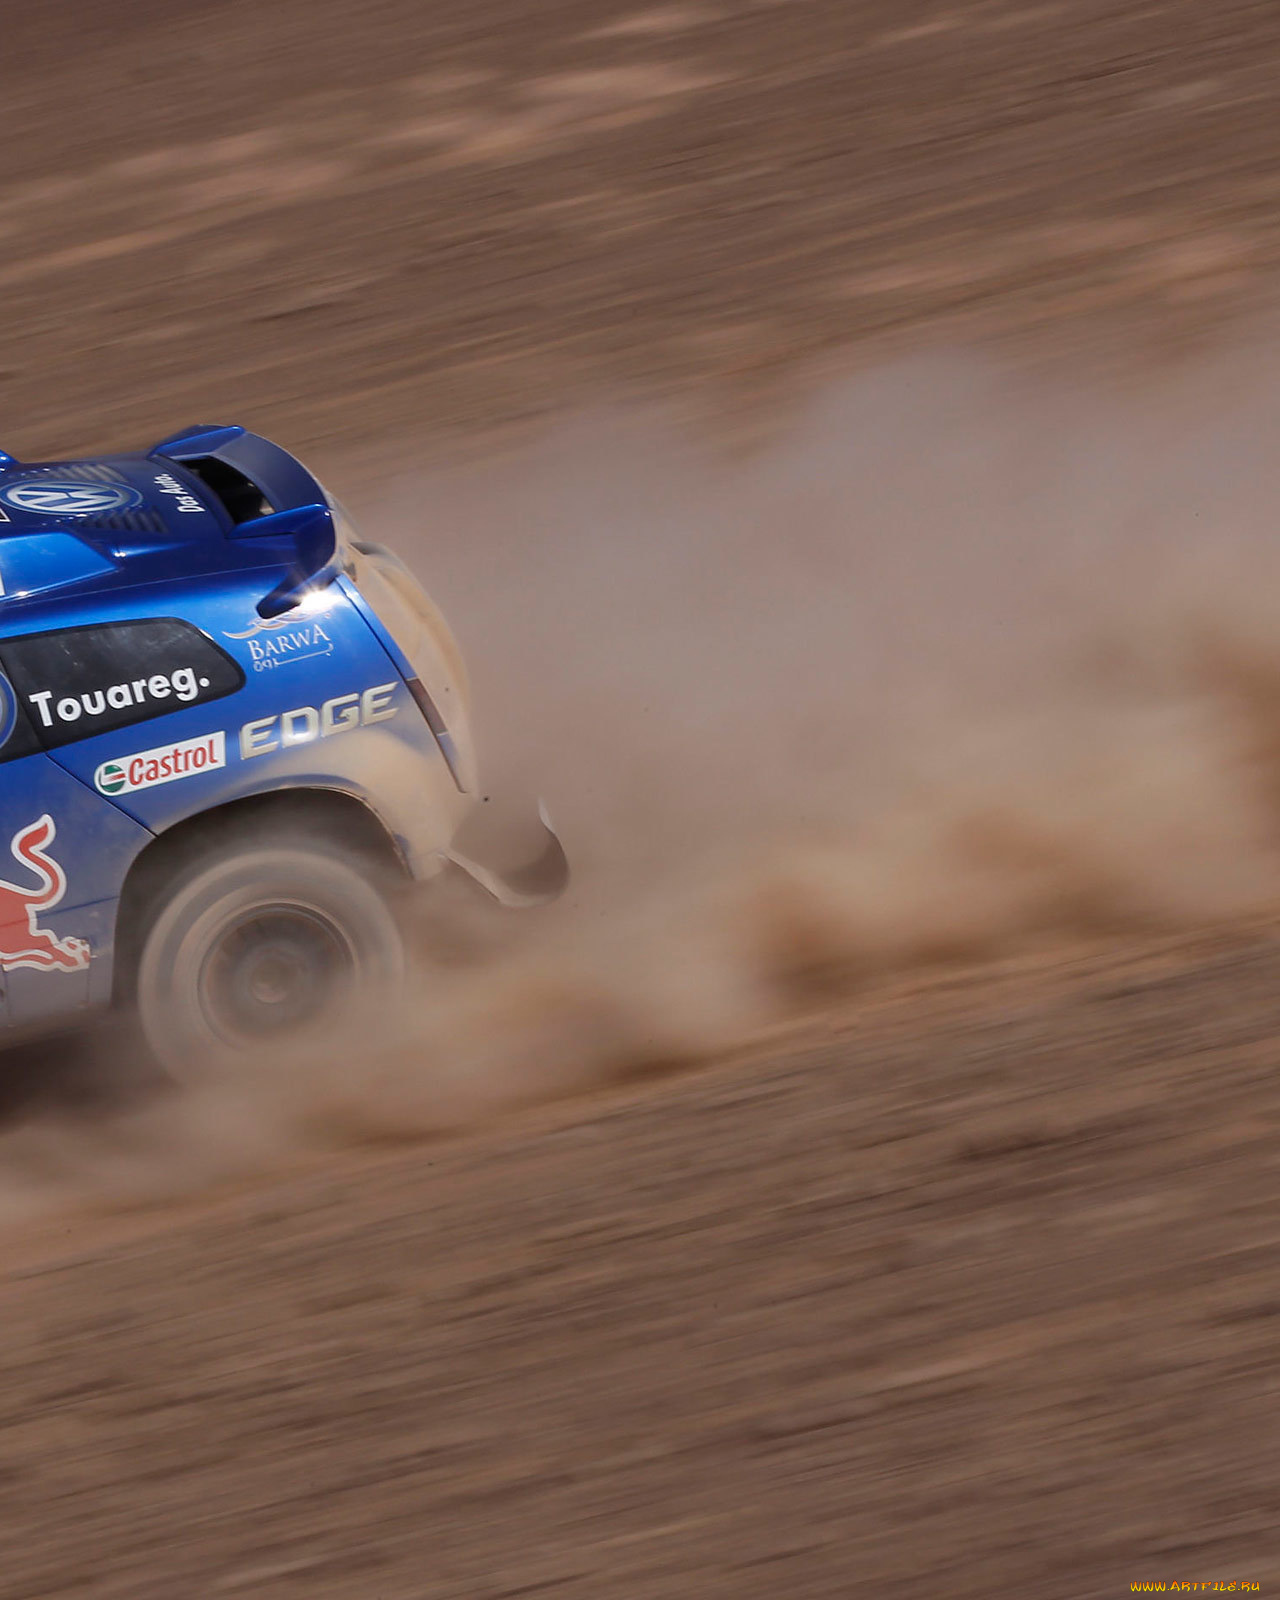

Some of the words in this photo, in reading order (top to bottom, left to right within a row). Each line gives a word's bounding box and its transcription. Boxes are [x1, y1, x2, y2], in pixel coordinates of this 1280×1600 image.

[176, 495, 206, 512] Das
[247, 623, 331, 661] BARWA
[28, 667, 210, 727] Touareg.
[240, 681, 400, 760] EDGE
[128, 739, 218, 786] Castrol
